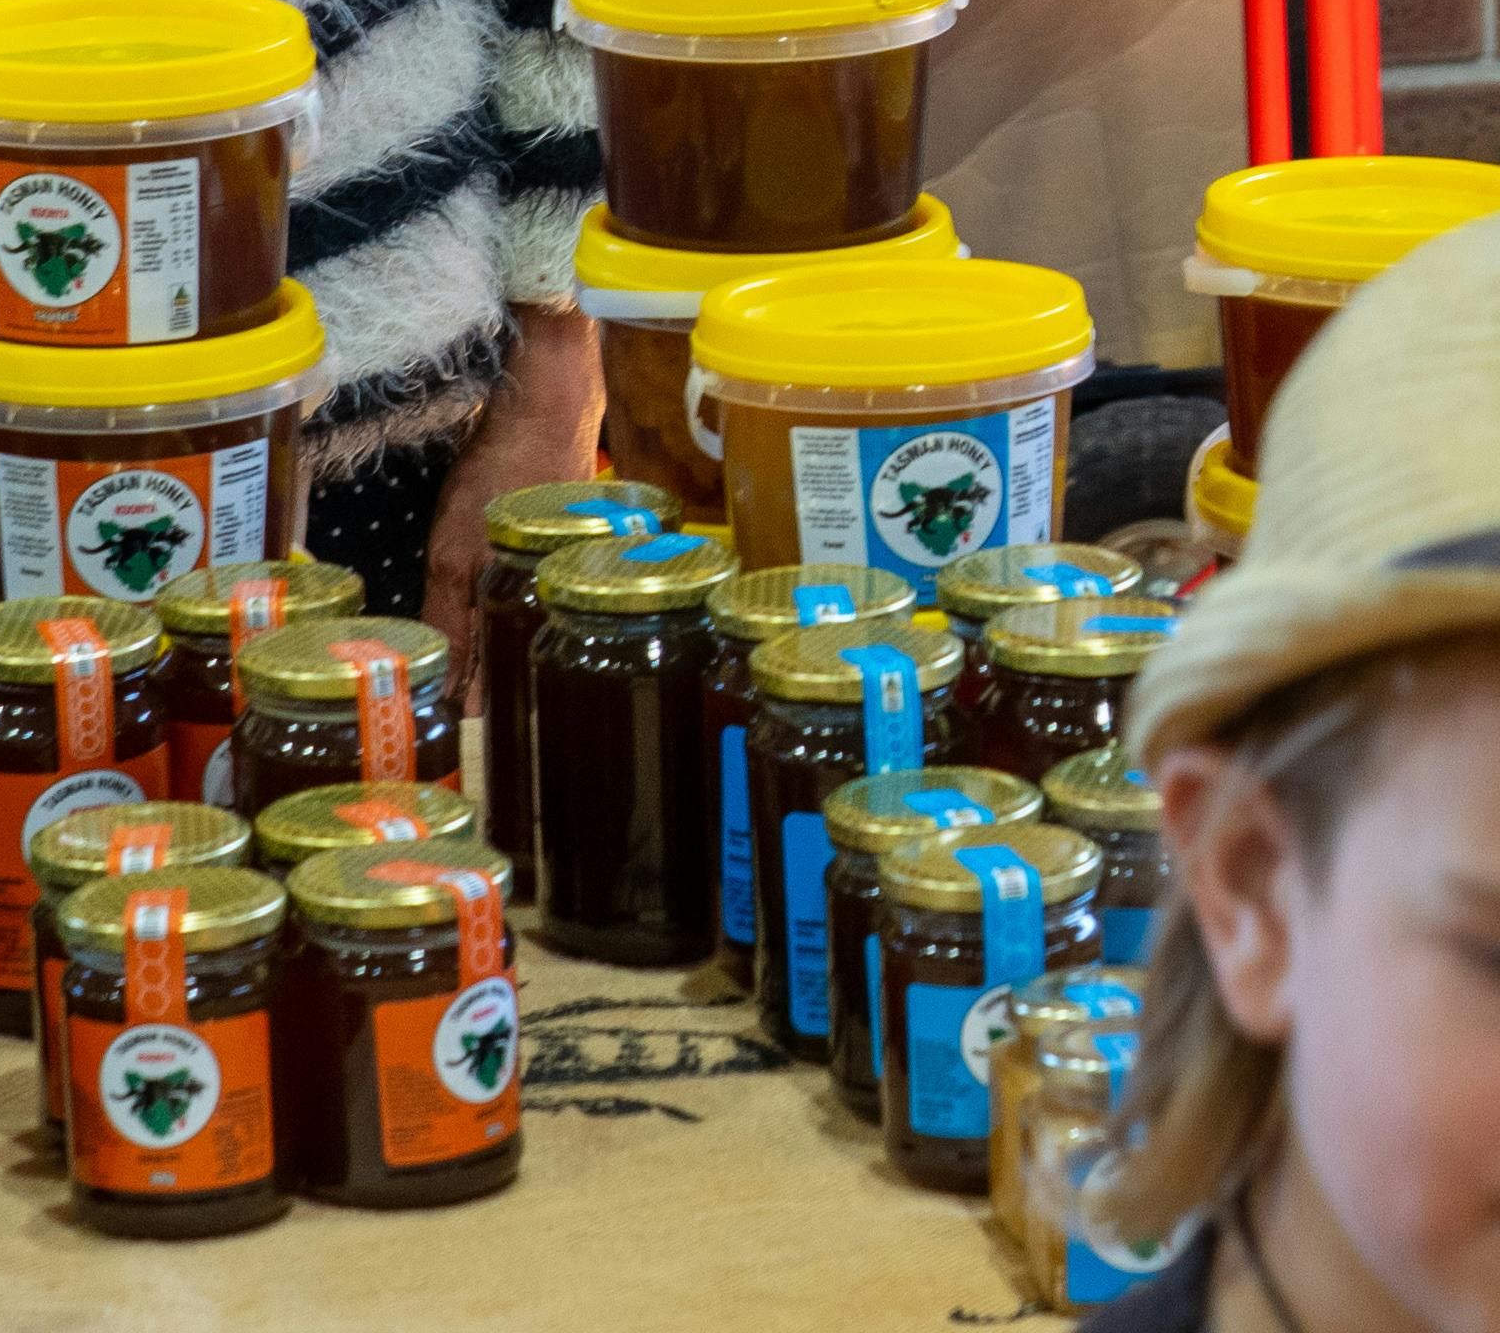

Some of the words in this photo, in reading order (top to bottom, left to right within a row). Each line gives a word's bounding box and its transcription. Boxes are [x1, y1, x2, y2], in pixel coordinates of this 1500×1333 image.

[57, 181, 107, 220] HONEY
[882, 436, 943, 482] TASMAN
[947, 437, 992, 472] HONEY
[76, 473, 140, 517] TASMAN
[146, 473, 193, 511] HONEY
